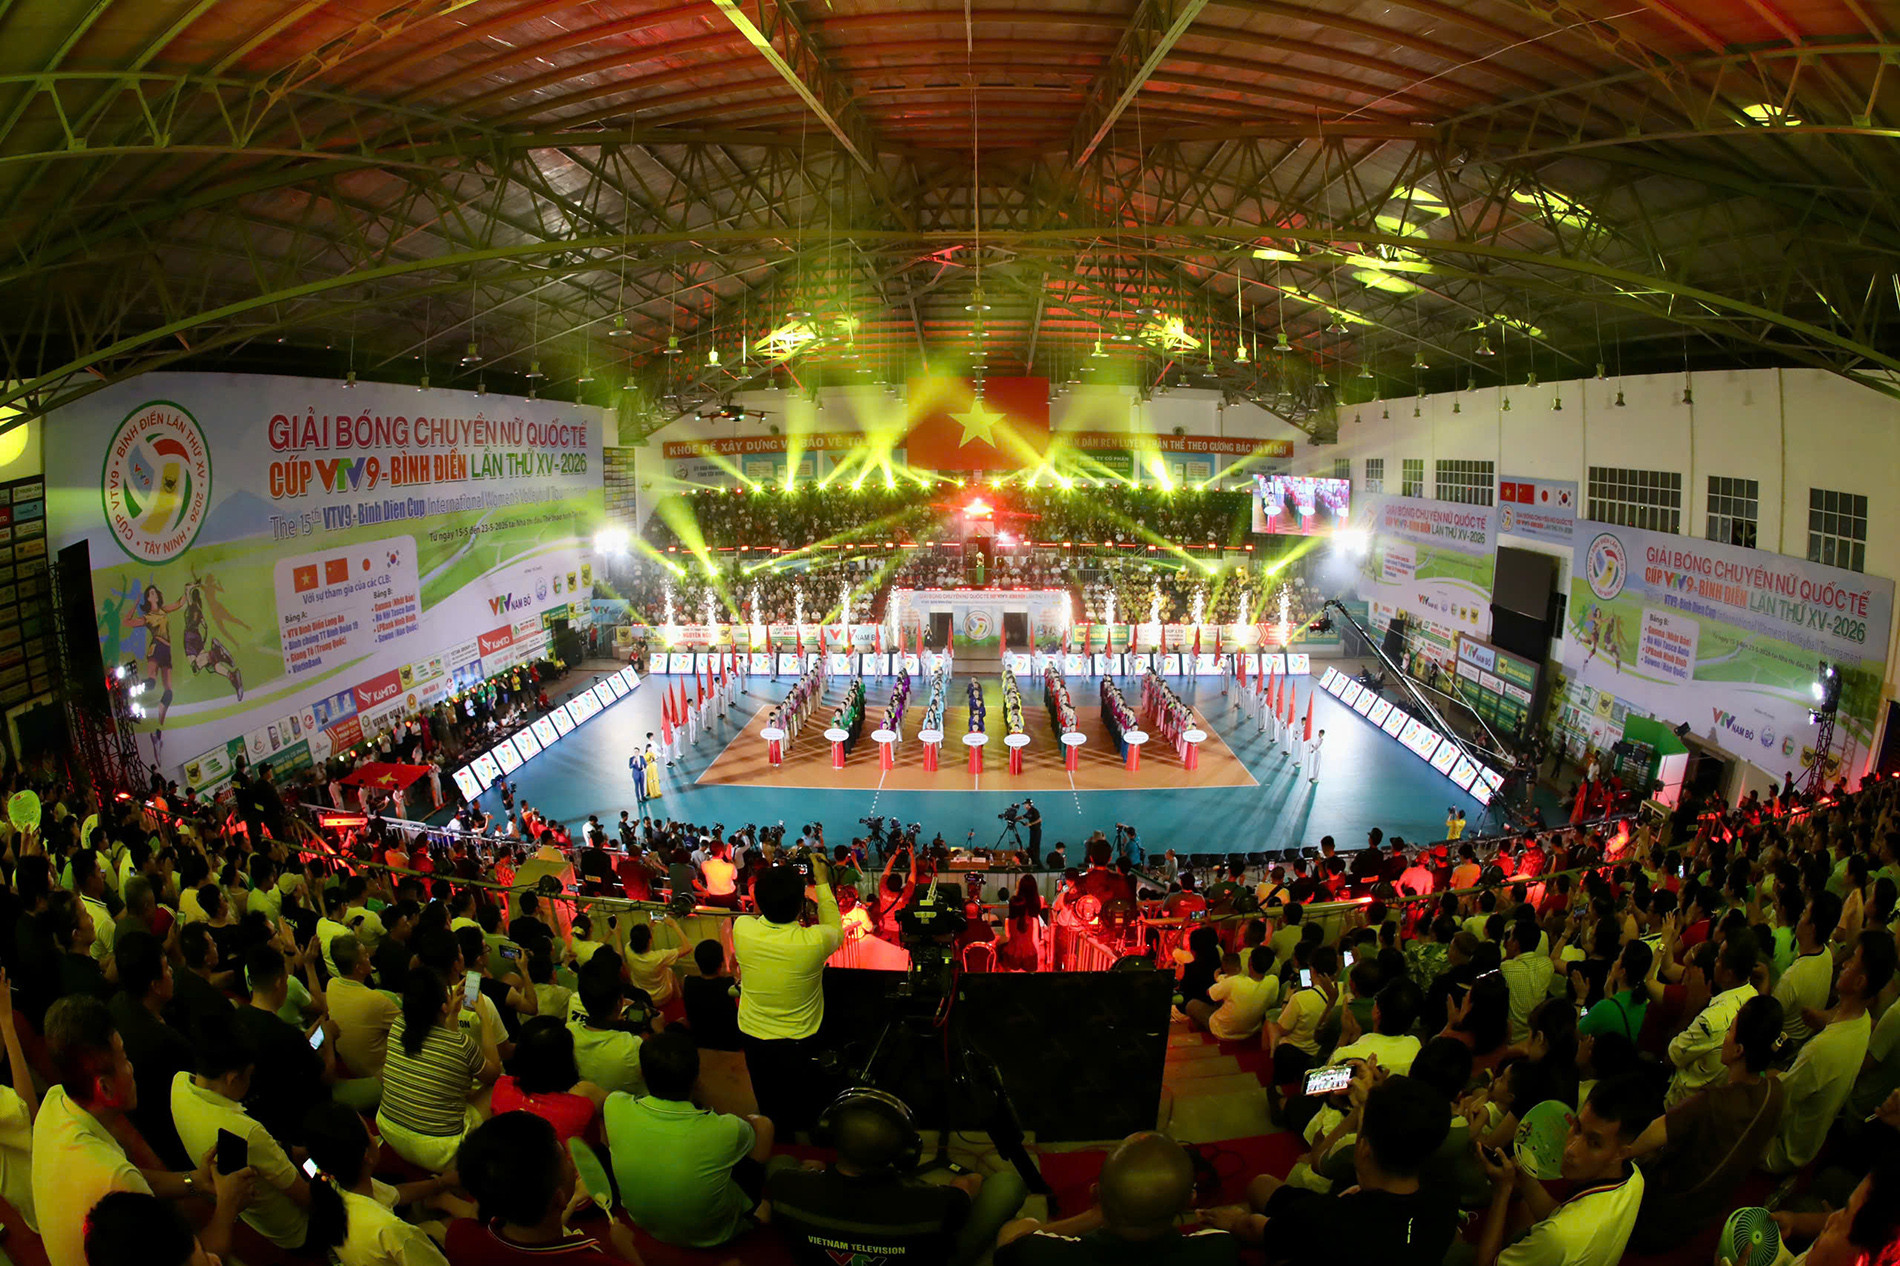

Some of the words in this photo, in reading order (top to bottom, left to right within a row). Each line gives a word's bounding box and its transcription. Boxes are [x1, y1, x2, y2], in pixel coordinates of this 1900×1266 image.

[268, 406, 330, 450] GIẢI
[414, 412, 497, 448] CHUYỀN
[500, 416, 524, 446] NỮ
[526, 418, 569, 448] QUỐC
[570, 420, 588, 448] TẾ
[116, 425, 138, 458] BÌNH
[196, 460, 206, 478] XV
[670, 440, 698, 456] KHỎE
[720, 437, 742, 452] XÂY
[746, 437, 778, 452] DỰNG
[1170, 437, 1185, 450] THỂ
[1188, 441, 1206, 451] THEO
[1210, 440, 1234, 452] GƯƠNG
[1236, 443, 1250, 453] BÁC
[434, 448, 468, 482] ĐIỀN
[472, 446, 503, 480] LẦN
[506, 448, 534, 478] THỨ
[110, 471, 120, 510] VTV9
[190, 492, 204, 524] 2026
[270, 515, 296, 540] The
[300, 508, 322, 536] 15th
[408, 497, 425, 518] Cup
[427, 491, 484, 516] International
[1454, 512, 1476, 528] QUỐC
[1476, 514, 1487, 530] TẾ
[144, 540, 160, 554] TÂY
[164, 531, 187, 554] NINH
[302, 594, 315, 605] Với
[316, 592, 324, 602] sự
[325, 588, 342, 600] tham
[344, 584, 354, 597] gia
[355, 581, 366, 592] của
[366, 579, 377, 590] các
[378, 574, 392, 586] CLB:
[1646, 545, 1672, 568] GIẢI
[1674, 550, 1712, 575] BÓNG
[1714, 560, 1774, 592] CHUYỀN
[1776, 572, 1798, 598] NỮ
[1800, 580, 1846, 610] QUỐC
[1848, 590, 1872, 618] TẾ
[488, 592, 512, 616] VTV
[512, 597, 523, 610] NAM
[524, 594, 532, 606] BỘ
[1724, 584, 1748, 609] ĐIỀN
[1750, 590, 1776, 617] LẦN
[1779, 599, 1807, 626] THỨ
[284, 612, 300, 624] Bảng
[287, 626, 298, 639] VTV
[325, 617, 338, 630] Long
[352, 621, 358, 630] 19
[1706, 606, 1716, 620] Cup
[1787, 629, 1818, 652] Volleyball
[1820, 640, 1862, 664] Tournament
[290, 649, 307, 662] Giang
[314, 640, 332, 656] (Trung
[332, 636, 347, 650] Quốc)
[1463, 642, 1478, 659] VTV
[292, 656, 322, 674] VietinBank
[1712, 706, 1736, 730] VTV
[1732, 724, 1745, 737] NAM
[1745, 728, 1754, 742] BỘ
[808, 1235, 848, 1250] VIETNAM
[851, 1243, 906, 1254] TELEVISION
